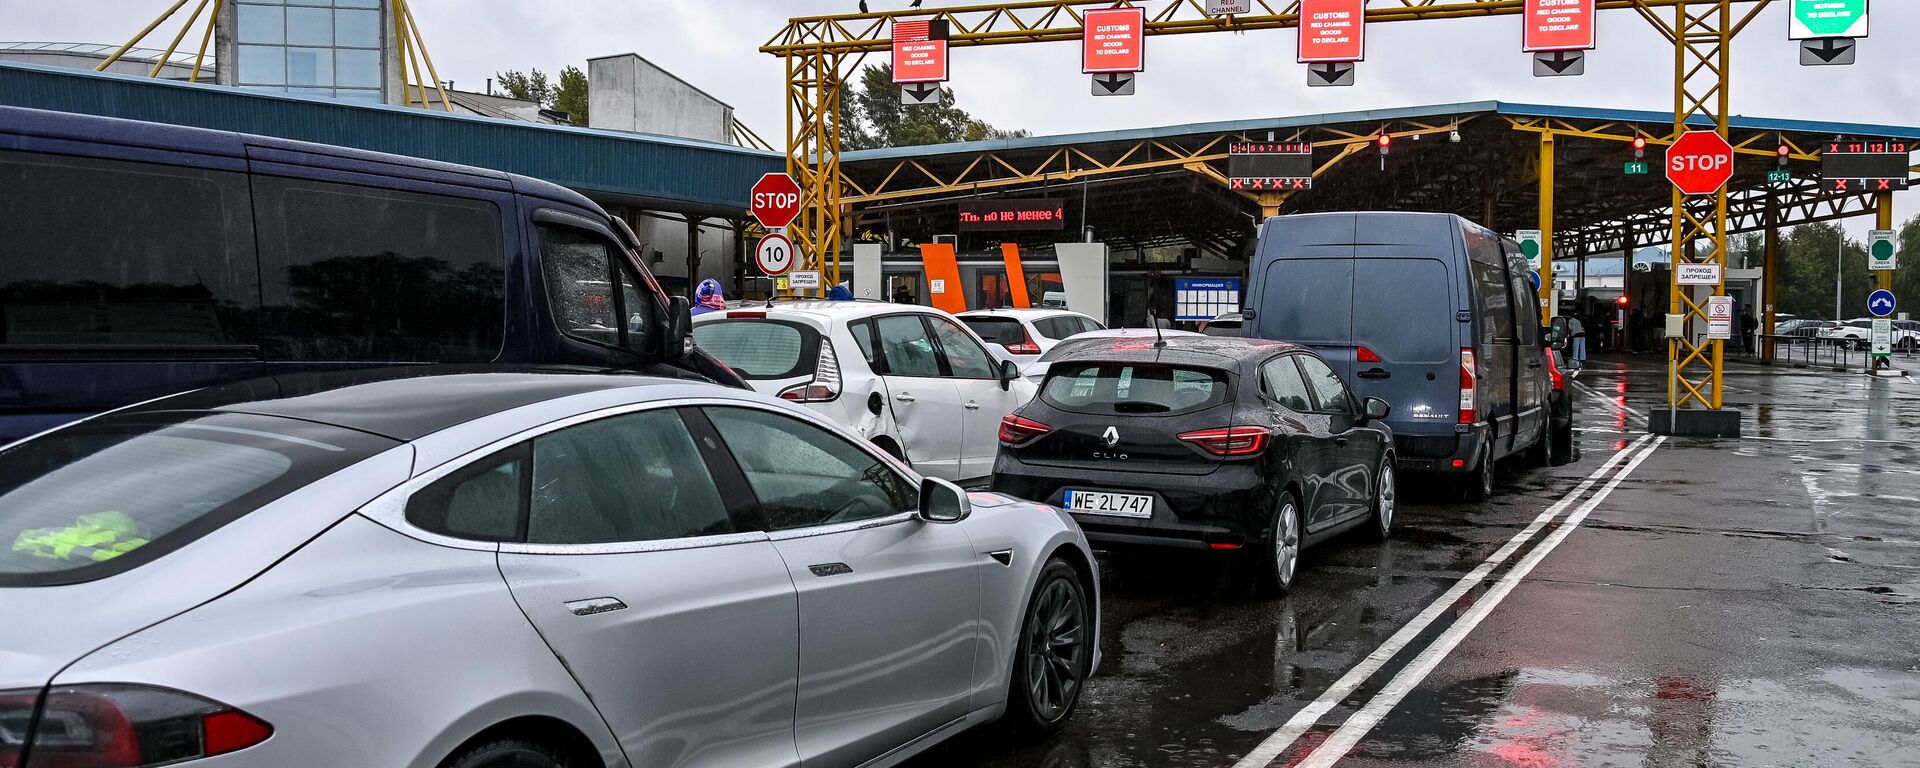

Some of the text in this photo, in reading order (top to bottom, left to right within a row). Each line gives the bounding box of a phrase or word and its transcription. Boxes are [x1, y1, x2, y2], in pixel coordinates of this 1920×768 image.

[1849, 144, 1905, 152] 11 12 13
[1631, 164, 1641, 172] 11
[1672, 154, 1728, 171] STOP
[755, 193, 797, 208] STOP
[1000, 212, 1014, 220] не
[1017, 211, 1052, 220] менее
[1055, 208, 1062, 219] 4
[766, 246, 784, 262] 10
[1075, 492, 1149, 513] WE 2L747
